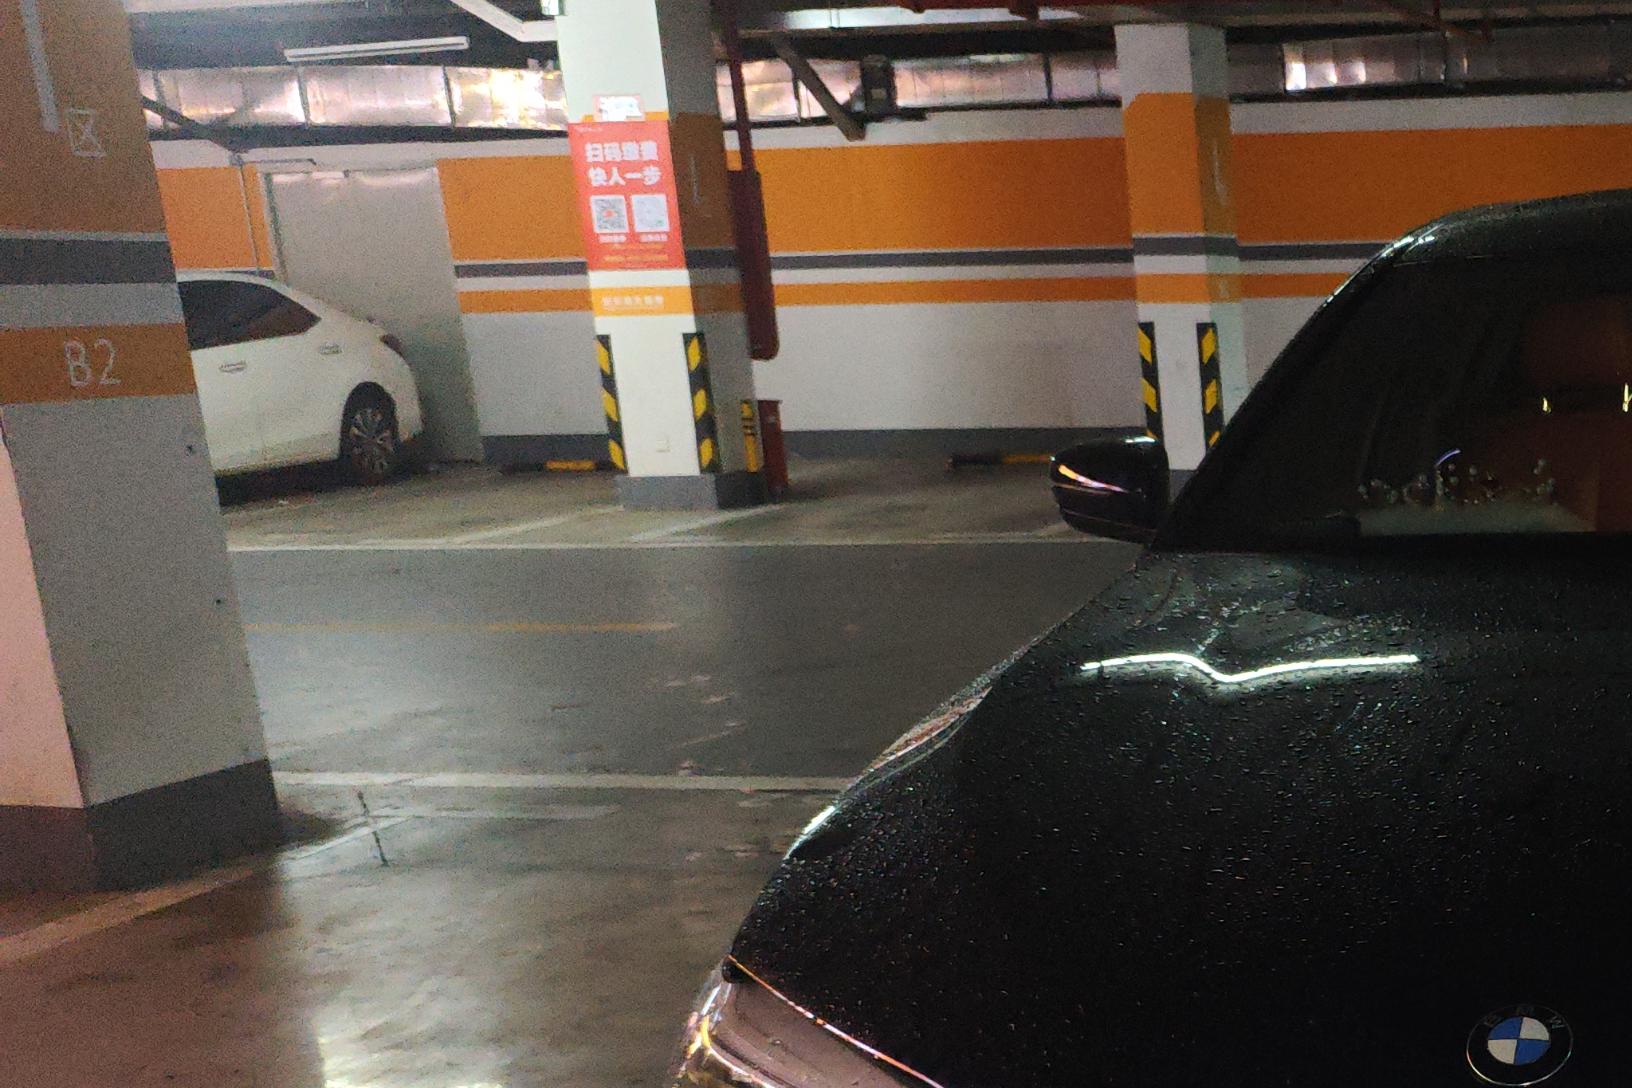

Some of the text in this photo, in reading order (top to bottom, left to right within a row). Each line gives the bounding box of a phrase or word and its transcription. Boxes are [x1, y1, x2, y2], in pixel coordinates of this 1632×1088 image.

[588, 165, 661, 187] 快人一步
[64, 339, 122, 388] B2
